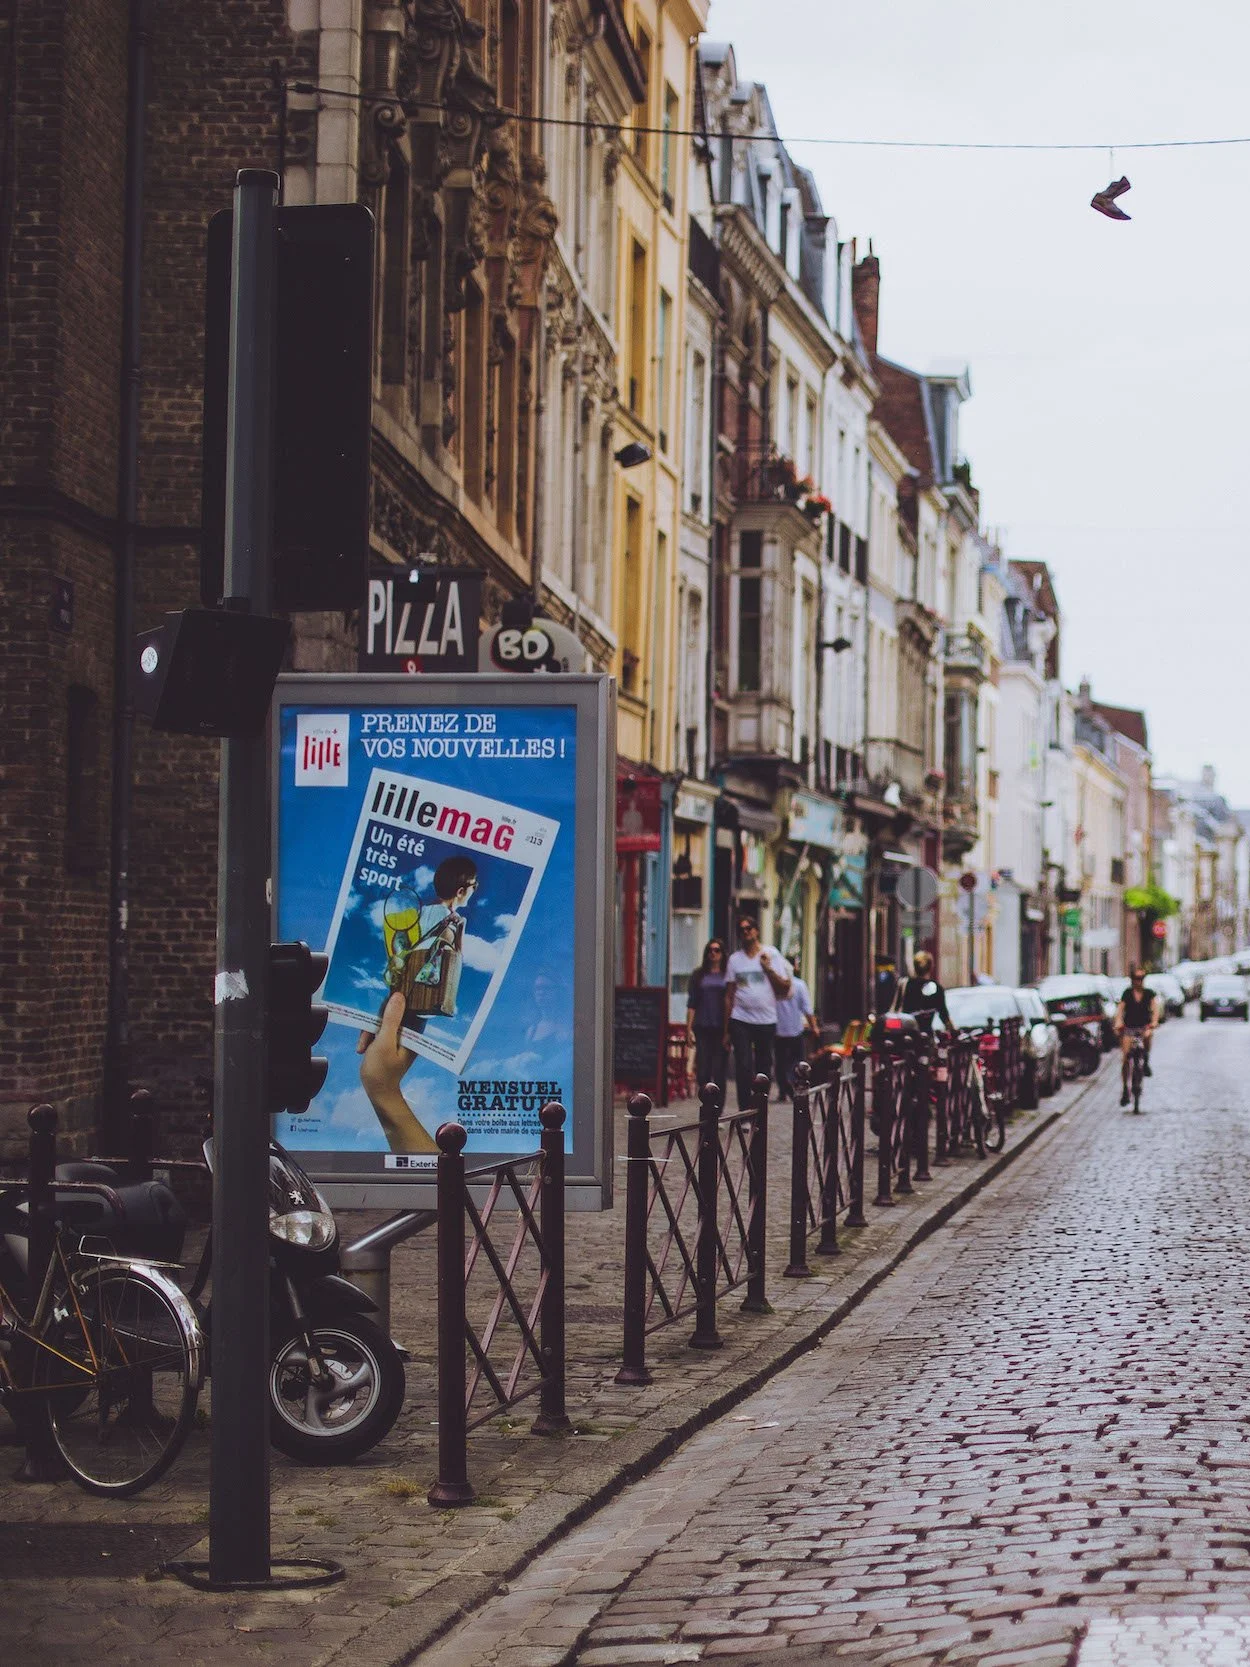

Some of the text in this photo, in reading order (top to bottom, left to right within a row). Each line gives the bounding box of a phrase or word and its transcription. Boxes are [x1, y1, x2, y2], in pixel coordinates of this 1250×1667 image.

[367, 579, 464, 656] PIZZA
[498, 629, 549, 661] BD
[361, 713, 497, 734] PRENEZ DE
[360, 738, 406, 759] VOS
[370, 826, 425, 857] Un été
[365, 846, 398, 869] très
[359, 866, 402, 891] sport
[457, 1081, 562, 1095] MENSUEL
[457, 1119, 473, 1127] Dans
[475, 1119, 490, 1127] votre
[509, 1119, 520, 1127] aux
[467, 1126, 482, 1135] dans
[483, 1127, 499, 1135] votre
[500, 1126, 520, 1135] mairie
[521, 1126, 529, 1135] de
[410, 1160, 438, 1168] Exterio
